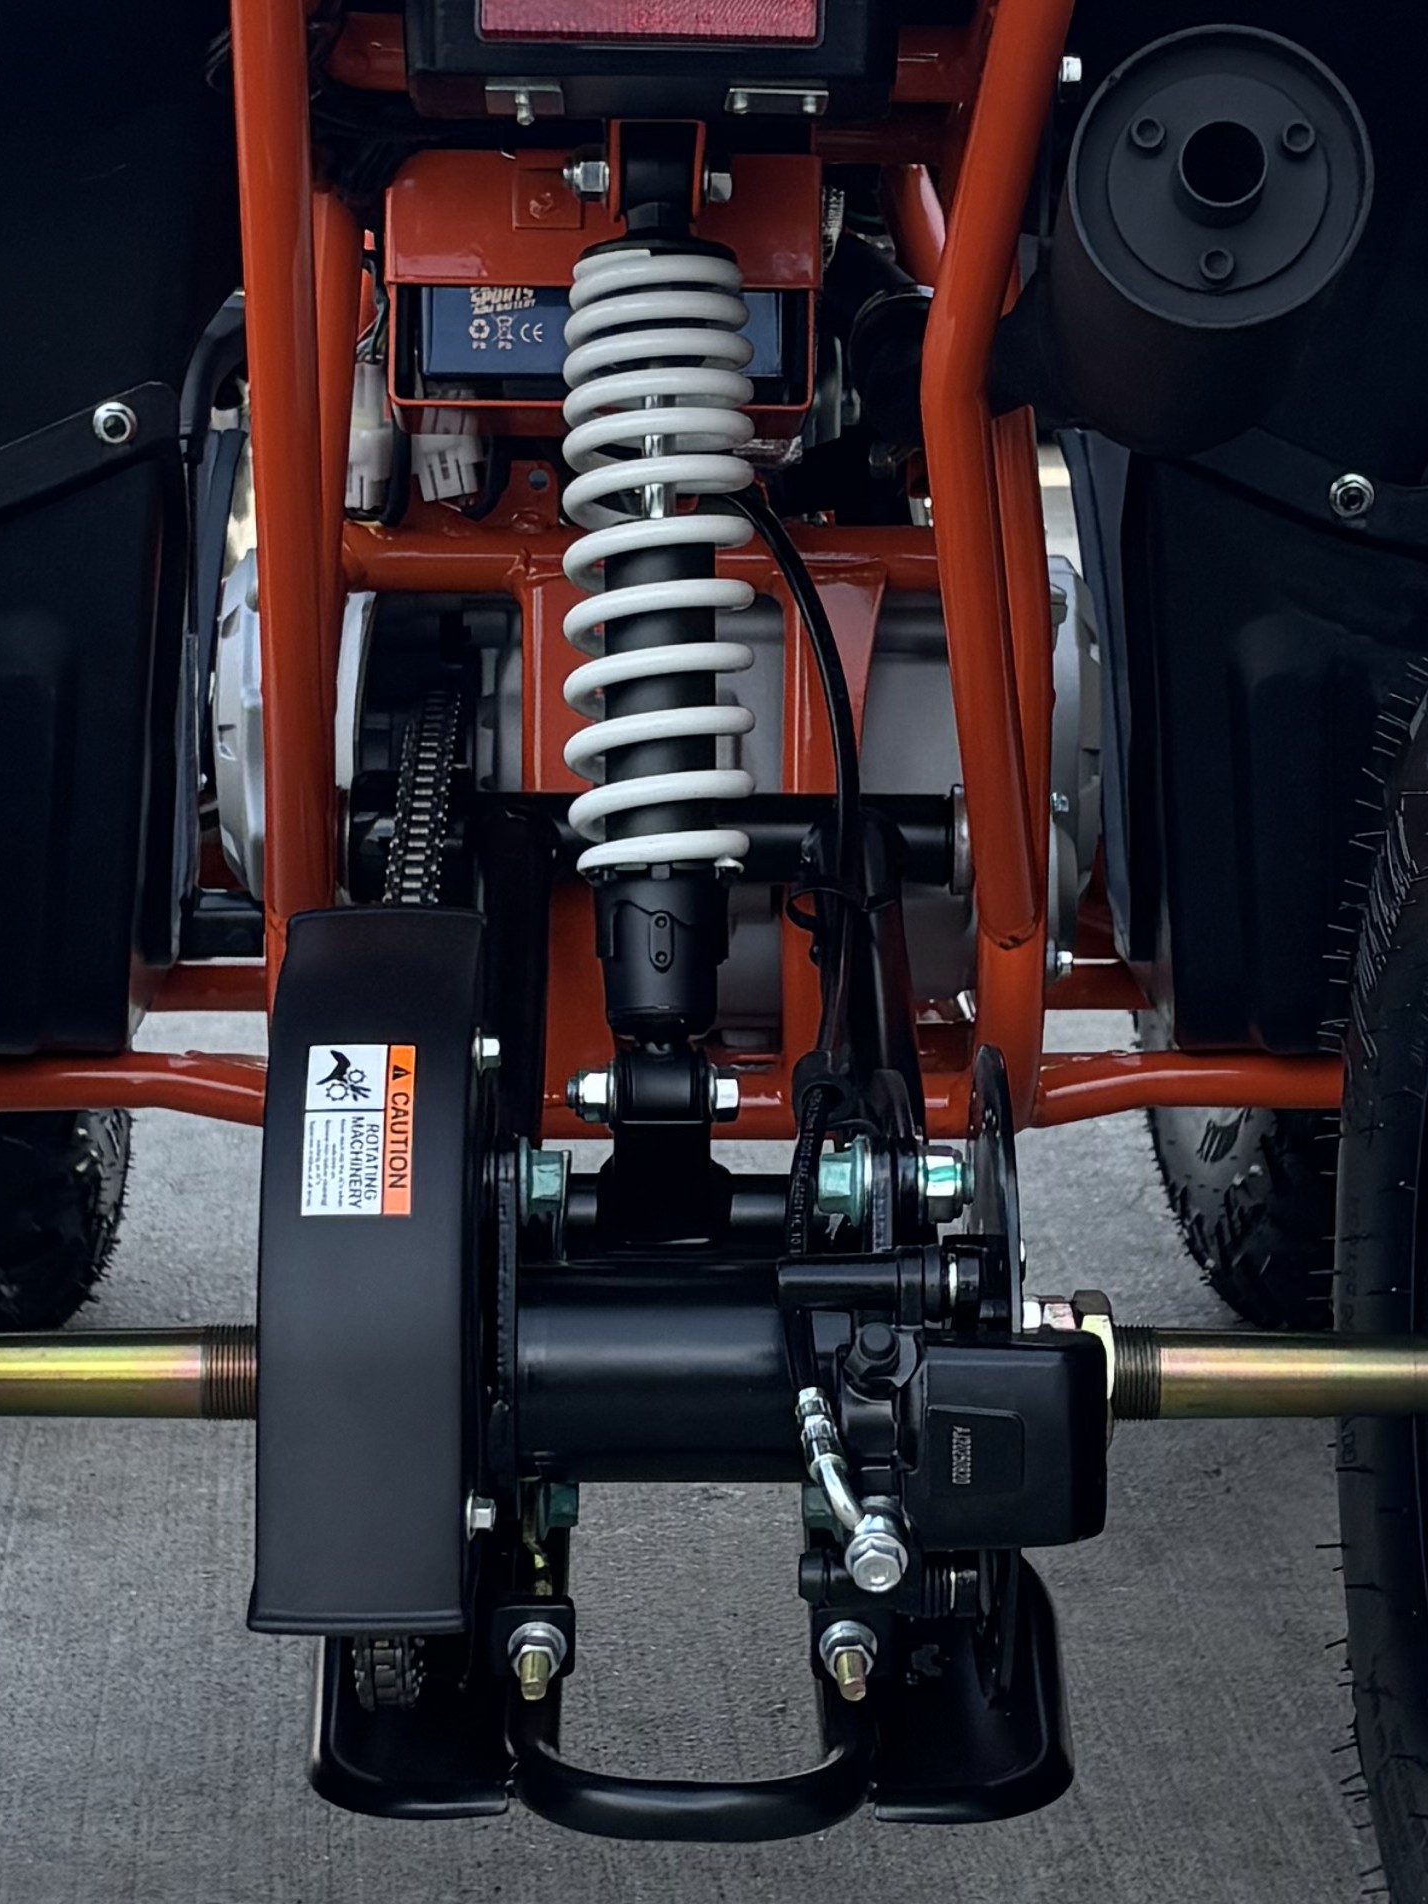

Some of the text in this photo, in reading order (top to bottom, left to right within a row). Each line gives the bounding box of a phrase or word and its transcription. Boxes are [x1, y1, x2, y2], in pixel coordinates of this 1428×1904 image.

[348, 1116, 365, 1209] MACHINERY
[364, 1123, 380, 1201] ROTATING
[388, 1092, 411, 1189] CAUTION
